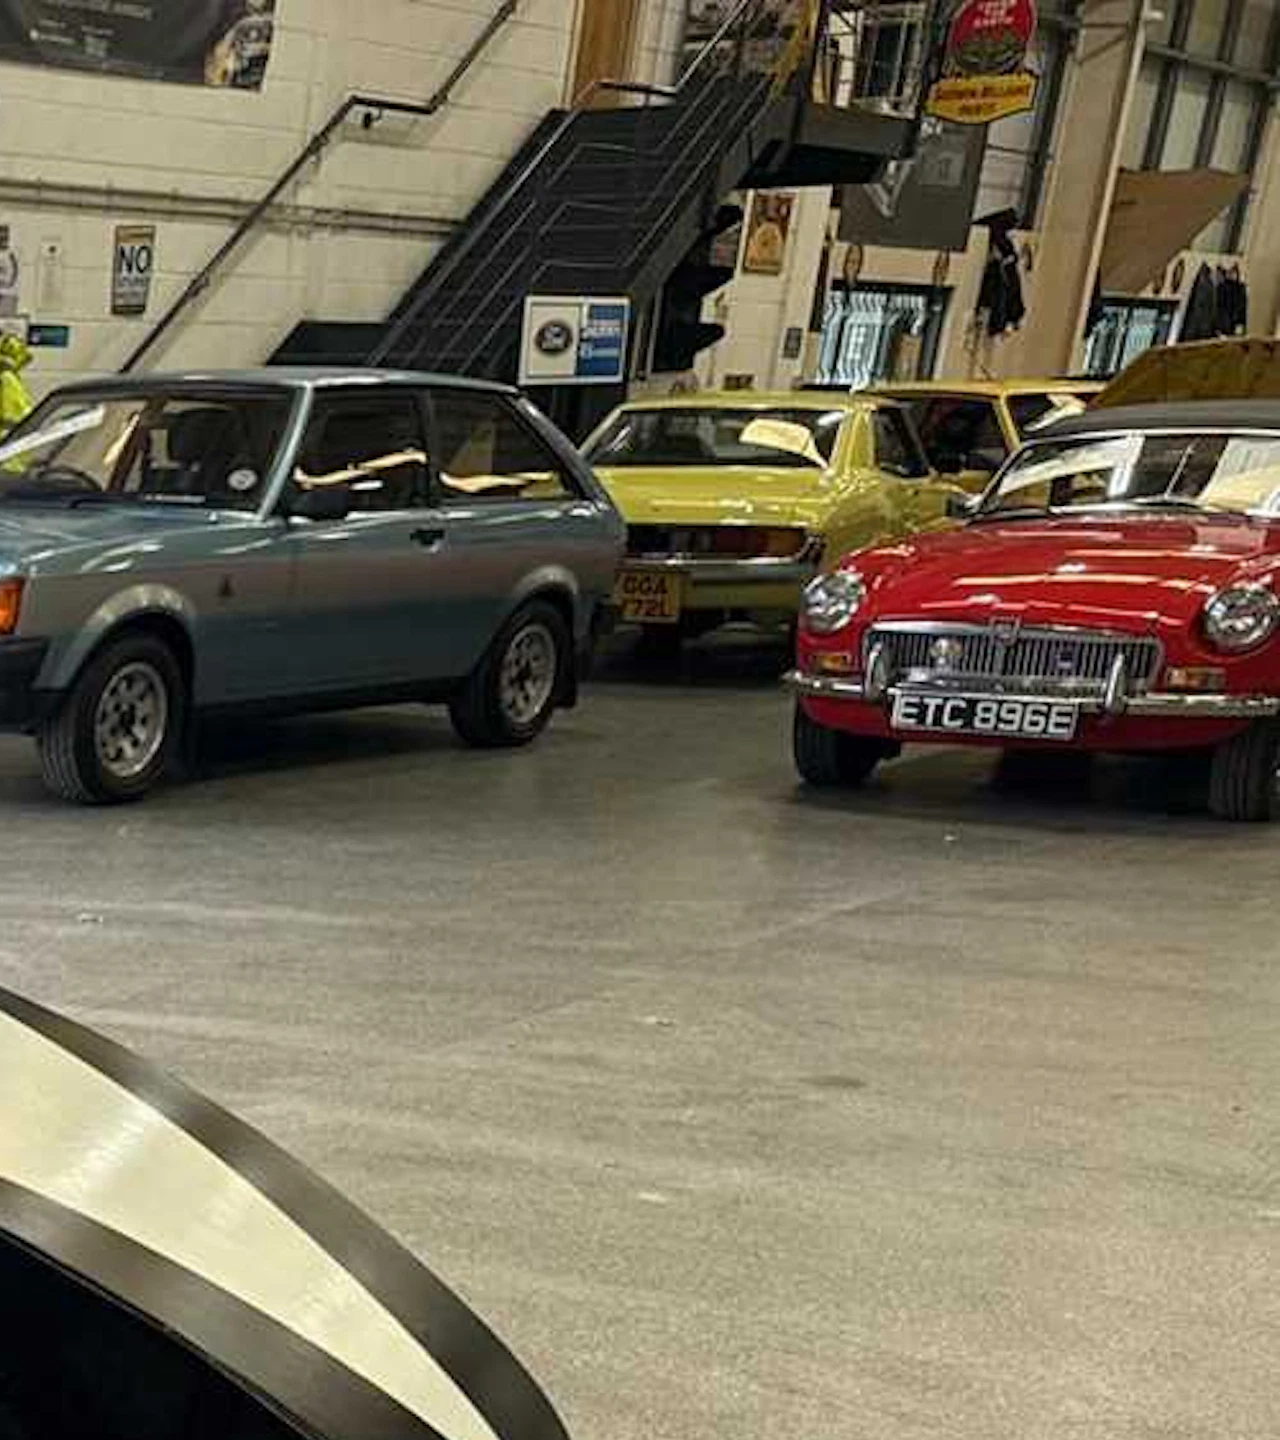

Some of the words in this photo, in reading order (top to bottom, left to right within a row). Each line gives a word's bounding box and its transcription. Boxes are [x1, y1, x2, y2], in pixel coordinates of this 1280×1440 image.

[120, 245, 153, 273] NO
[898, 696, 967, 727] ETC
[974, 701, 1074, 734] 896E
